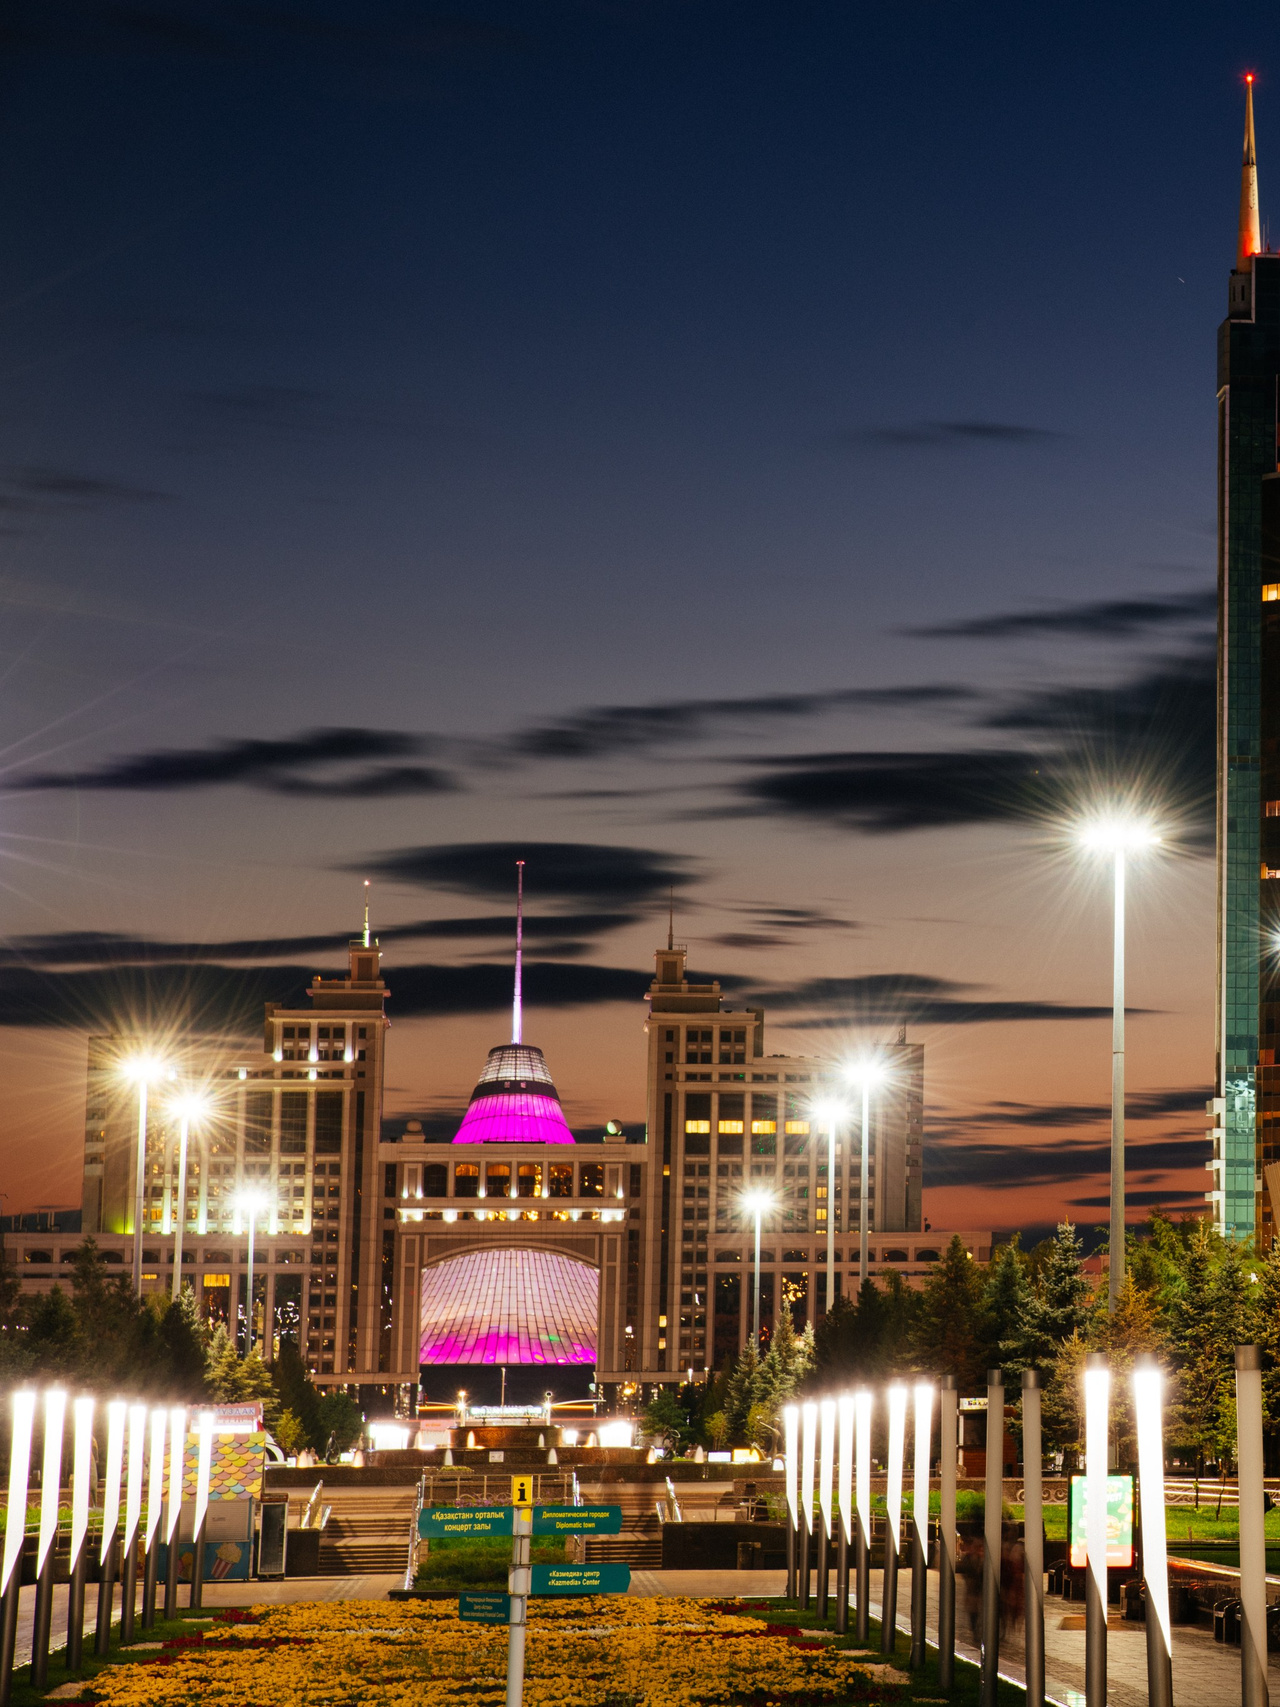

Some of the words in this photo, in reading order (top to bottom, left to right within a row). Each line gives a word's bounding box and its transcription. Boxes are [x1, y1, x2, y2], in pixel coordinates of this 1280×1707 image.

[431, 1511, 474, 1521] «Қазақстан»
[475, 1511, 505, 1520] орталық
[542, 1510, 588, 1519] Дипломатический
[444, 1523, 473, 1532] концерт
[556, 1521, 582, 1529] Diplomatic
[549, 1570, 583, 1578] «Казмедиа»
[548, 1578, 581, 1586] «Kazmedia»
[582, 1578, 601, 1586] Center
